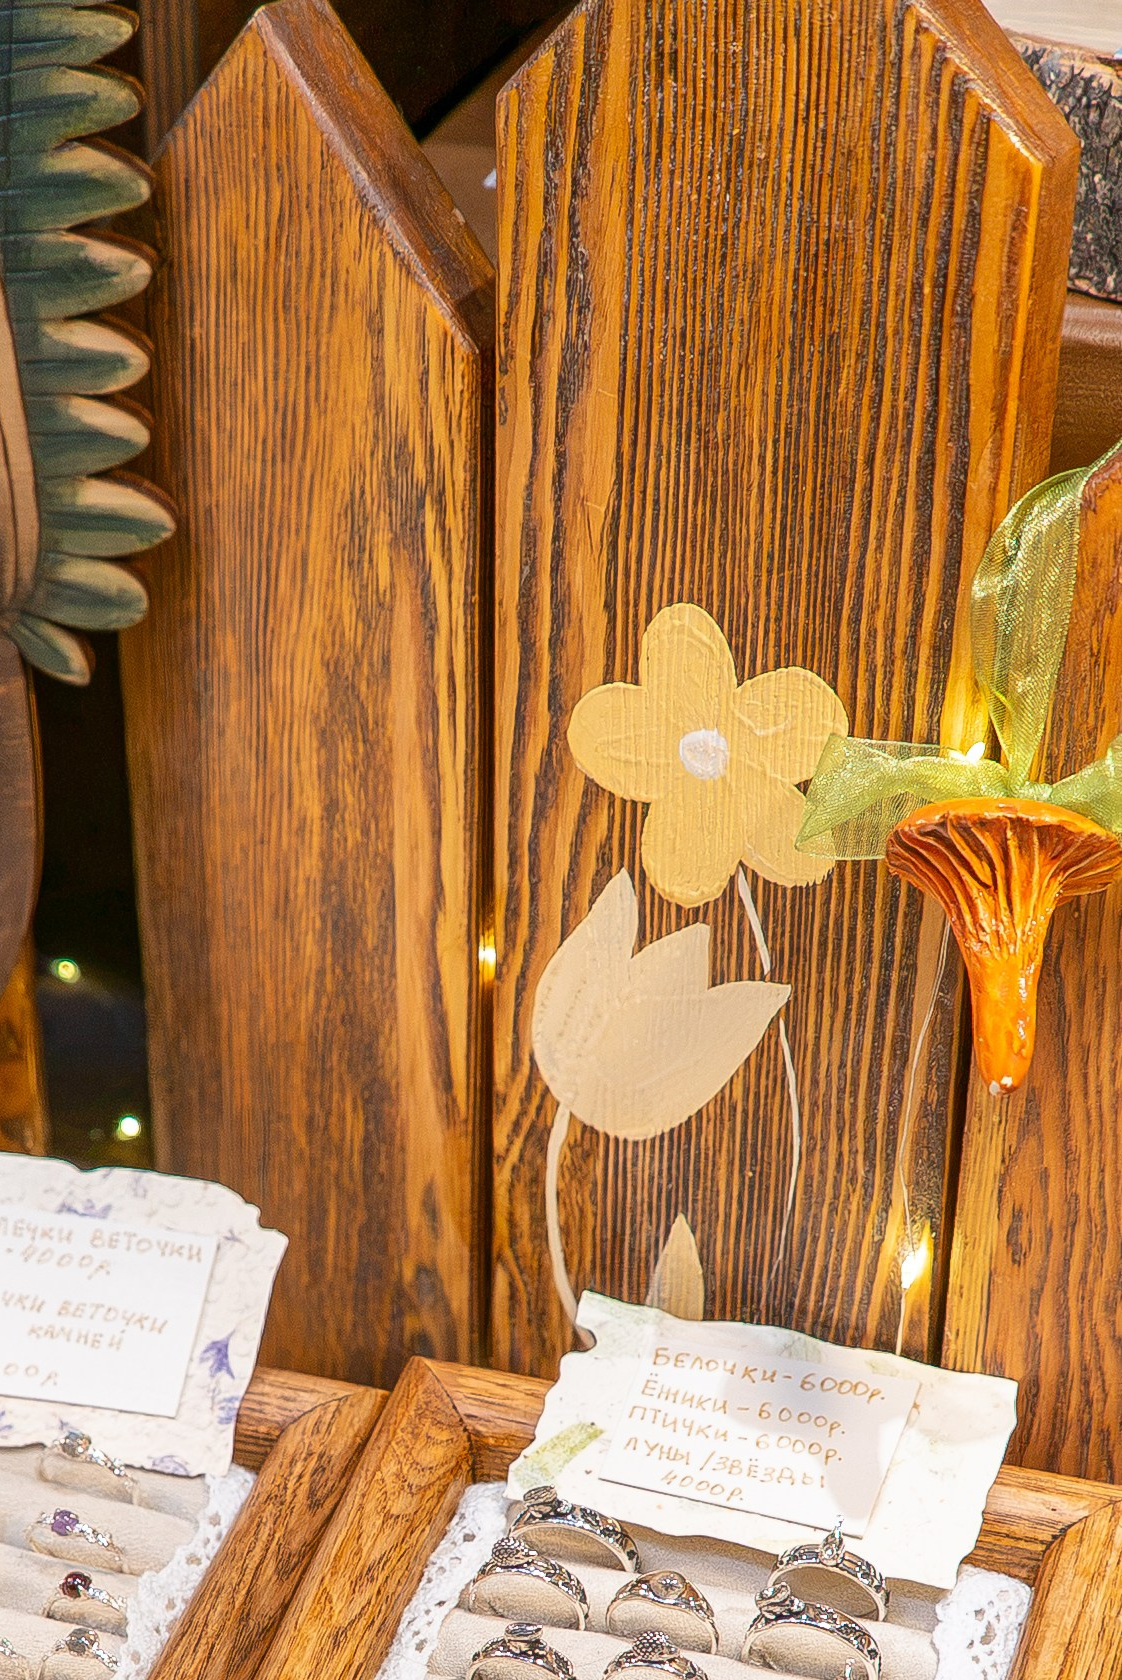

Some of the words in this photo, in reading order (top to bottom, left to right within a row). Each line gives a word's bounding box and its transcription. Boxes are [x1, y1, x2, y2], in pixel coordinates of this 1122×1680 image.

[89, 1227, 203, 1264] ВЕТОЧКИ
[57, 1299, 169, 1335] ВЕТОЧКИ
[27, 1324, 127, 1352] КАМНЕЙ
